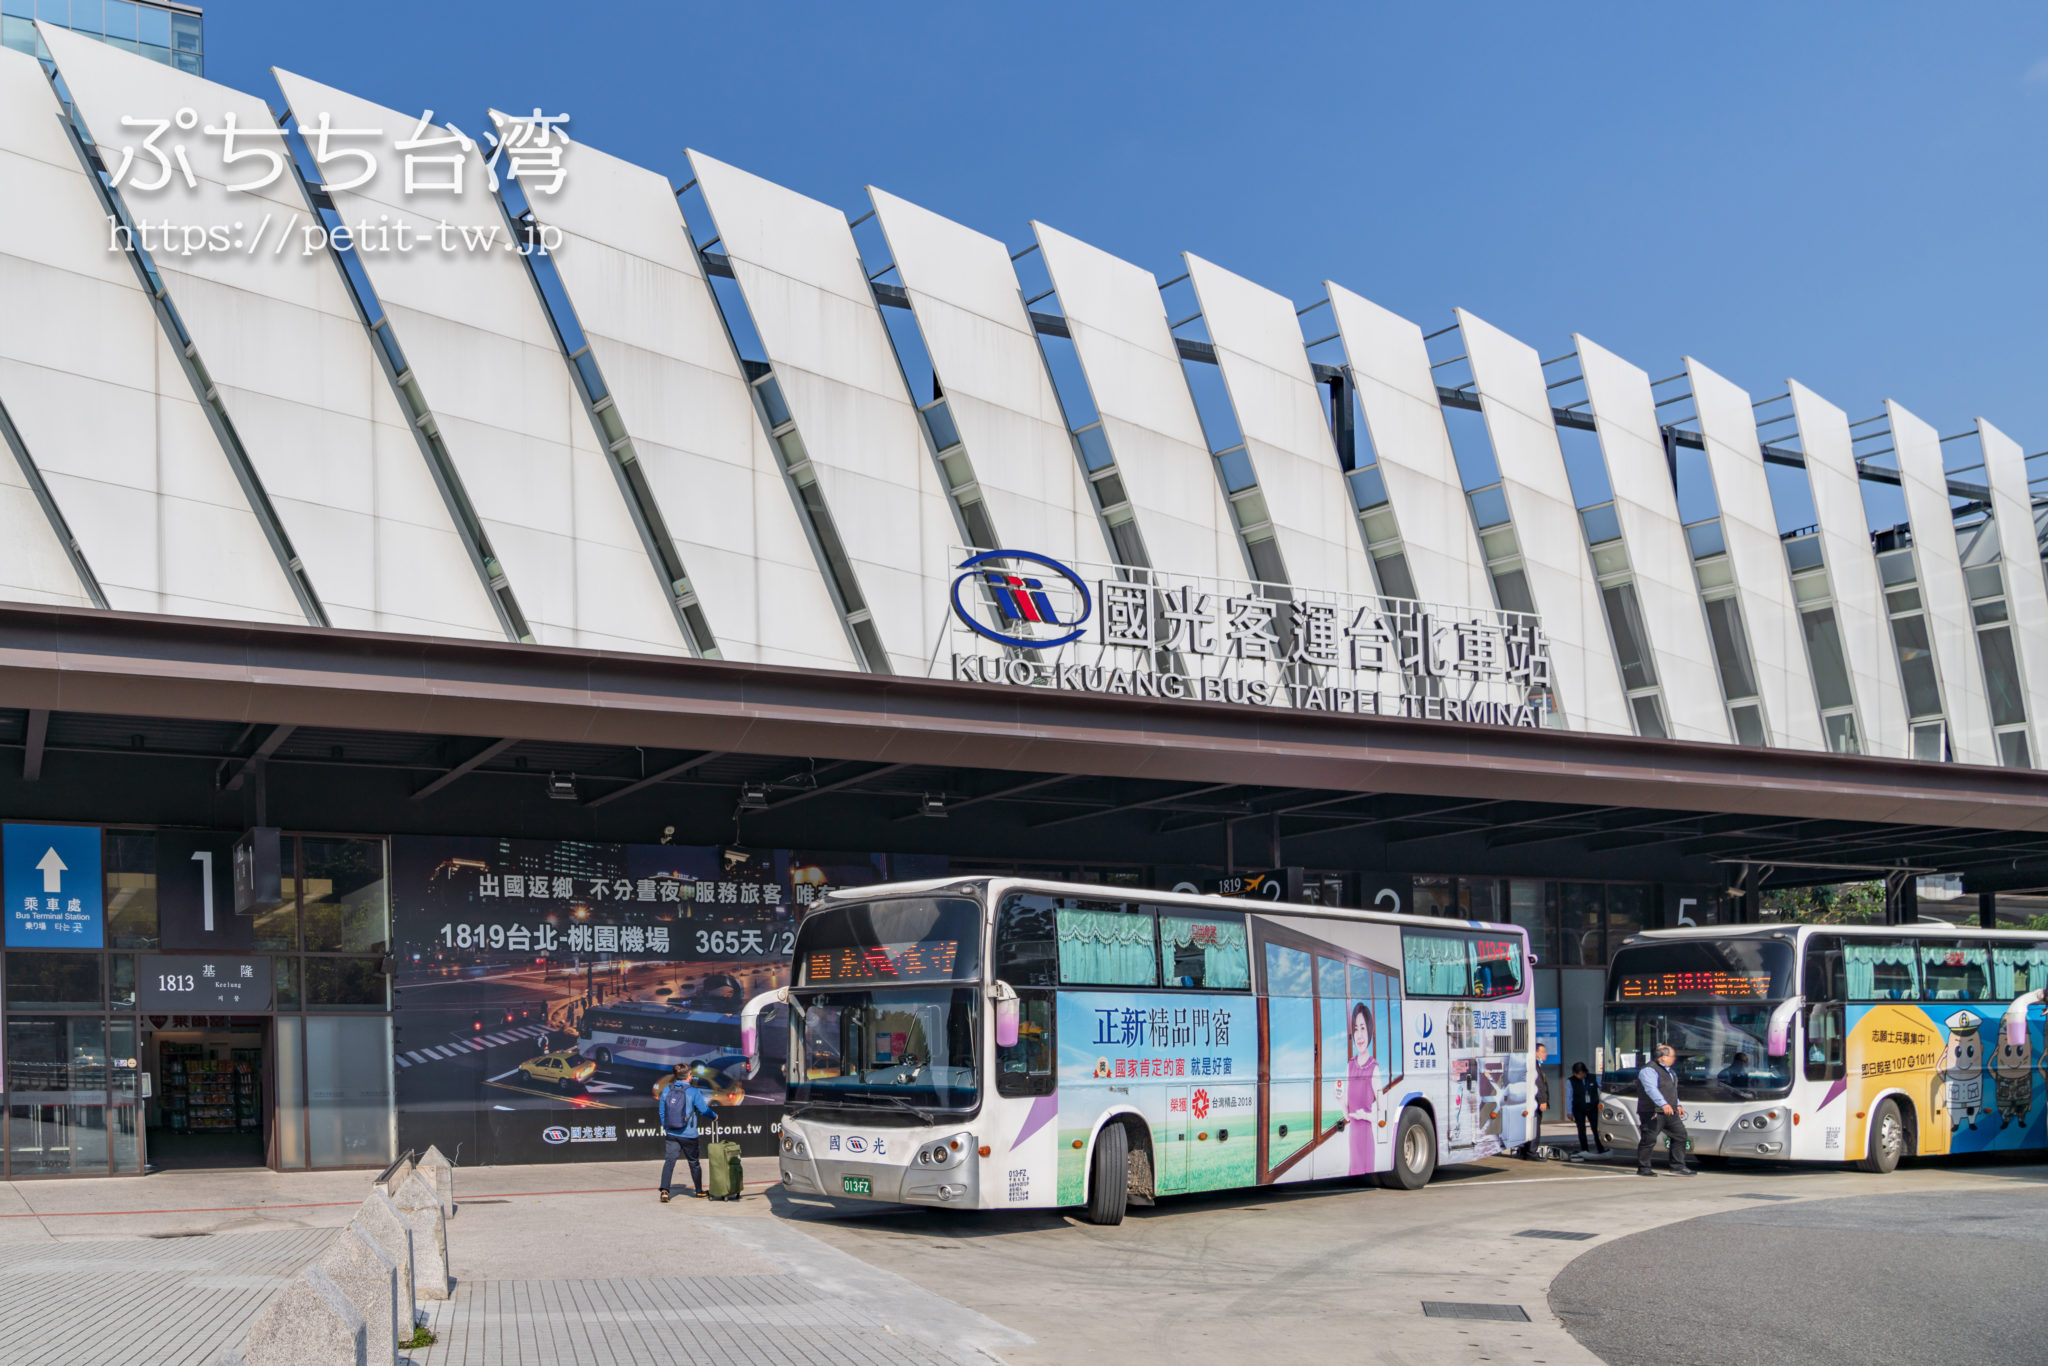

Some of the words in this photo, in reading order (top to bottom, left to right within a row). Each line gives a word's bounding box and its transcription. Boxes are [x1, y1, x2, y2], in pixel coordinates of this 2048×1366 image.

[1100, 577, 1552, 687] 國光客運台北車站
[952, 653, 1185, 698] KUO-KUANG
[1200, 676, 1269, 706] BUS
[1289, 683, 1383, 715] TAIPEI
[1400, 693, 1552, 729] TERMINAL
[190, 850, 214, 932] 1
[479, 874, 574, 900] 出國返鄉
[590, 878, 681, 903] 不分晝夜
[695, 881, 783, 905] 服務旅客
[1219, 877, 1241, 894] 1819
[15, 911, 30, 919] Bus
[32, 911, 63, 920] Terminal
[64, 912, 91, 921] Station
[440, 923, 670, 954] 1819台北-桃園機場
[202, 964, 254, 978] 基隆
[158, 974, 195, 992] 1813
[215, 981, 242, 989] Keelung
[1092, 1007, 1232, 1048] 正新精品門窗
[1473, 1010, 1507, 1030] 國光客運
[1413, 1042, 1436, 1056] CHA
[872, 1136, 887, 1155] 光
